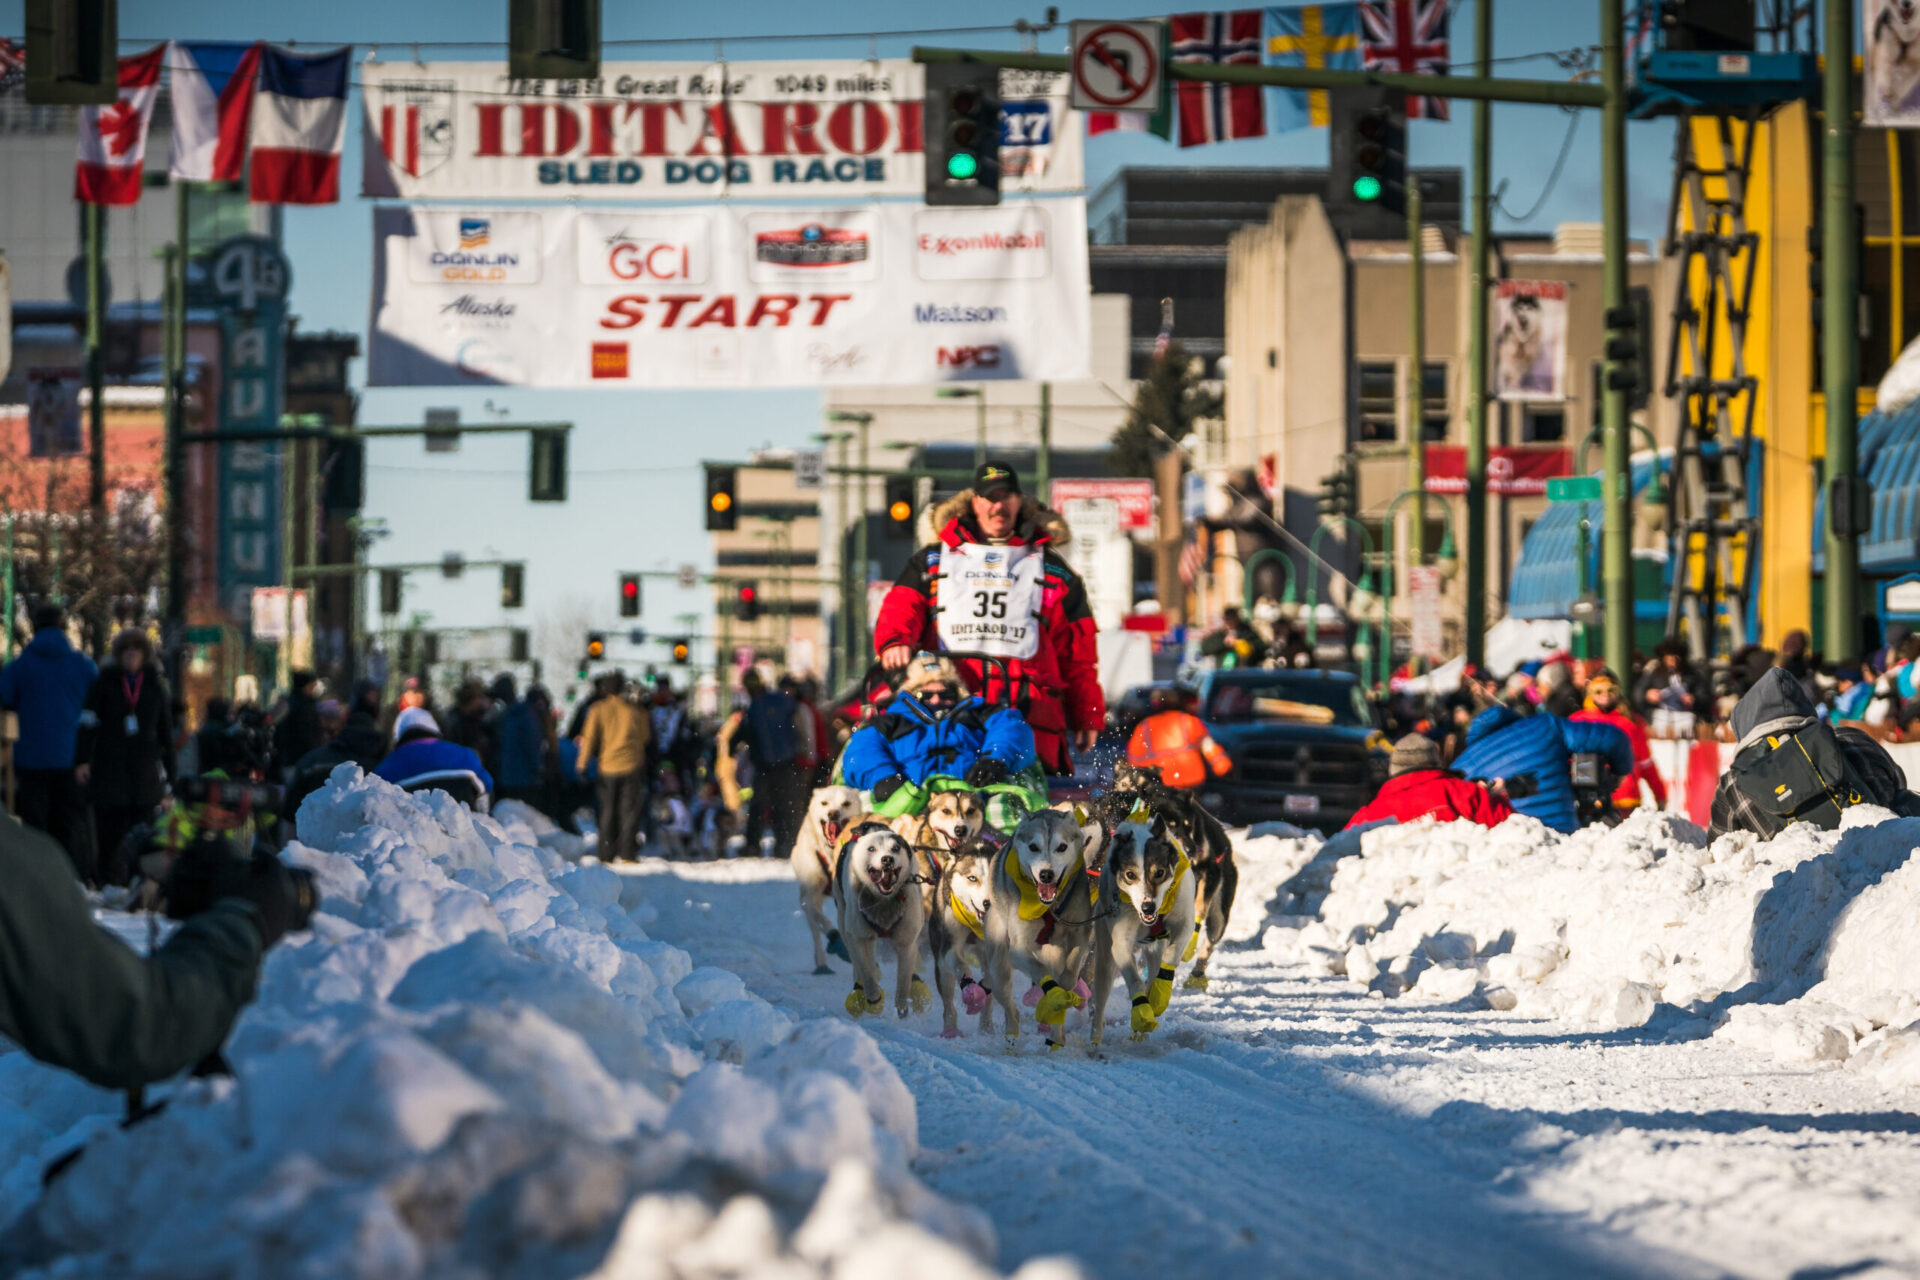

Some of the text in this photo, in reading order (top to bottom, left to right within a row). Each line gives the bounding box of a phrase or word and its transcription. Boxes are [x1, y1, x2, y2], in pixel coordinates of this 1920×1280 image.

[616, 74, 679, 96] Great
[774, 74, 892, 94] 1049 miles
[538, 158, 885, 184] SLED DOG RACE
[917, 231, 1046, 257] ExxonMobil
[430, 253, 519, 266] DONLIN
[609, 243, 690, 280] GCI
[442, 267, 507, 281] GOLD
[438, 294, 517, 319] Alaska
[600, 294, 852, 330] START
[914, 304, 1007, 324] Matson
[973, 590, 1008, 619] 35
[951, 623, 1008, 635] IDITAROD
